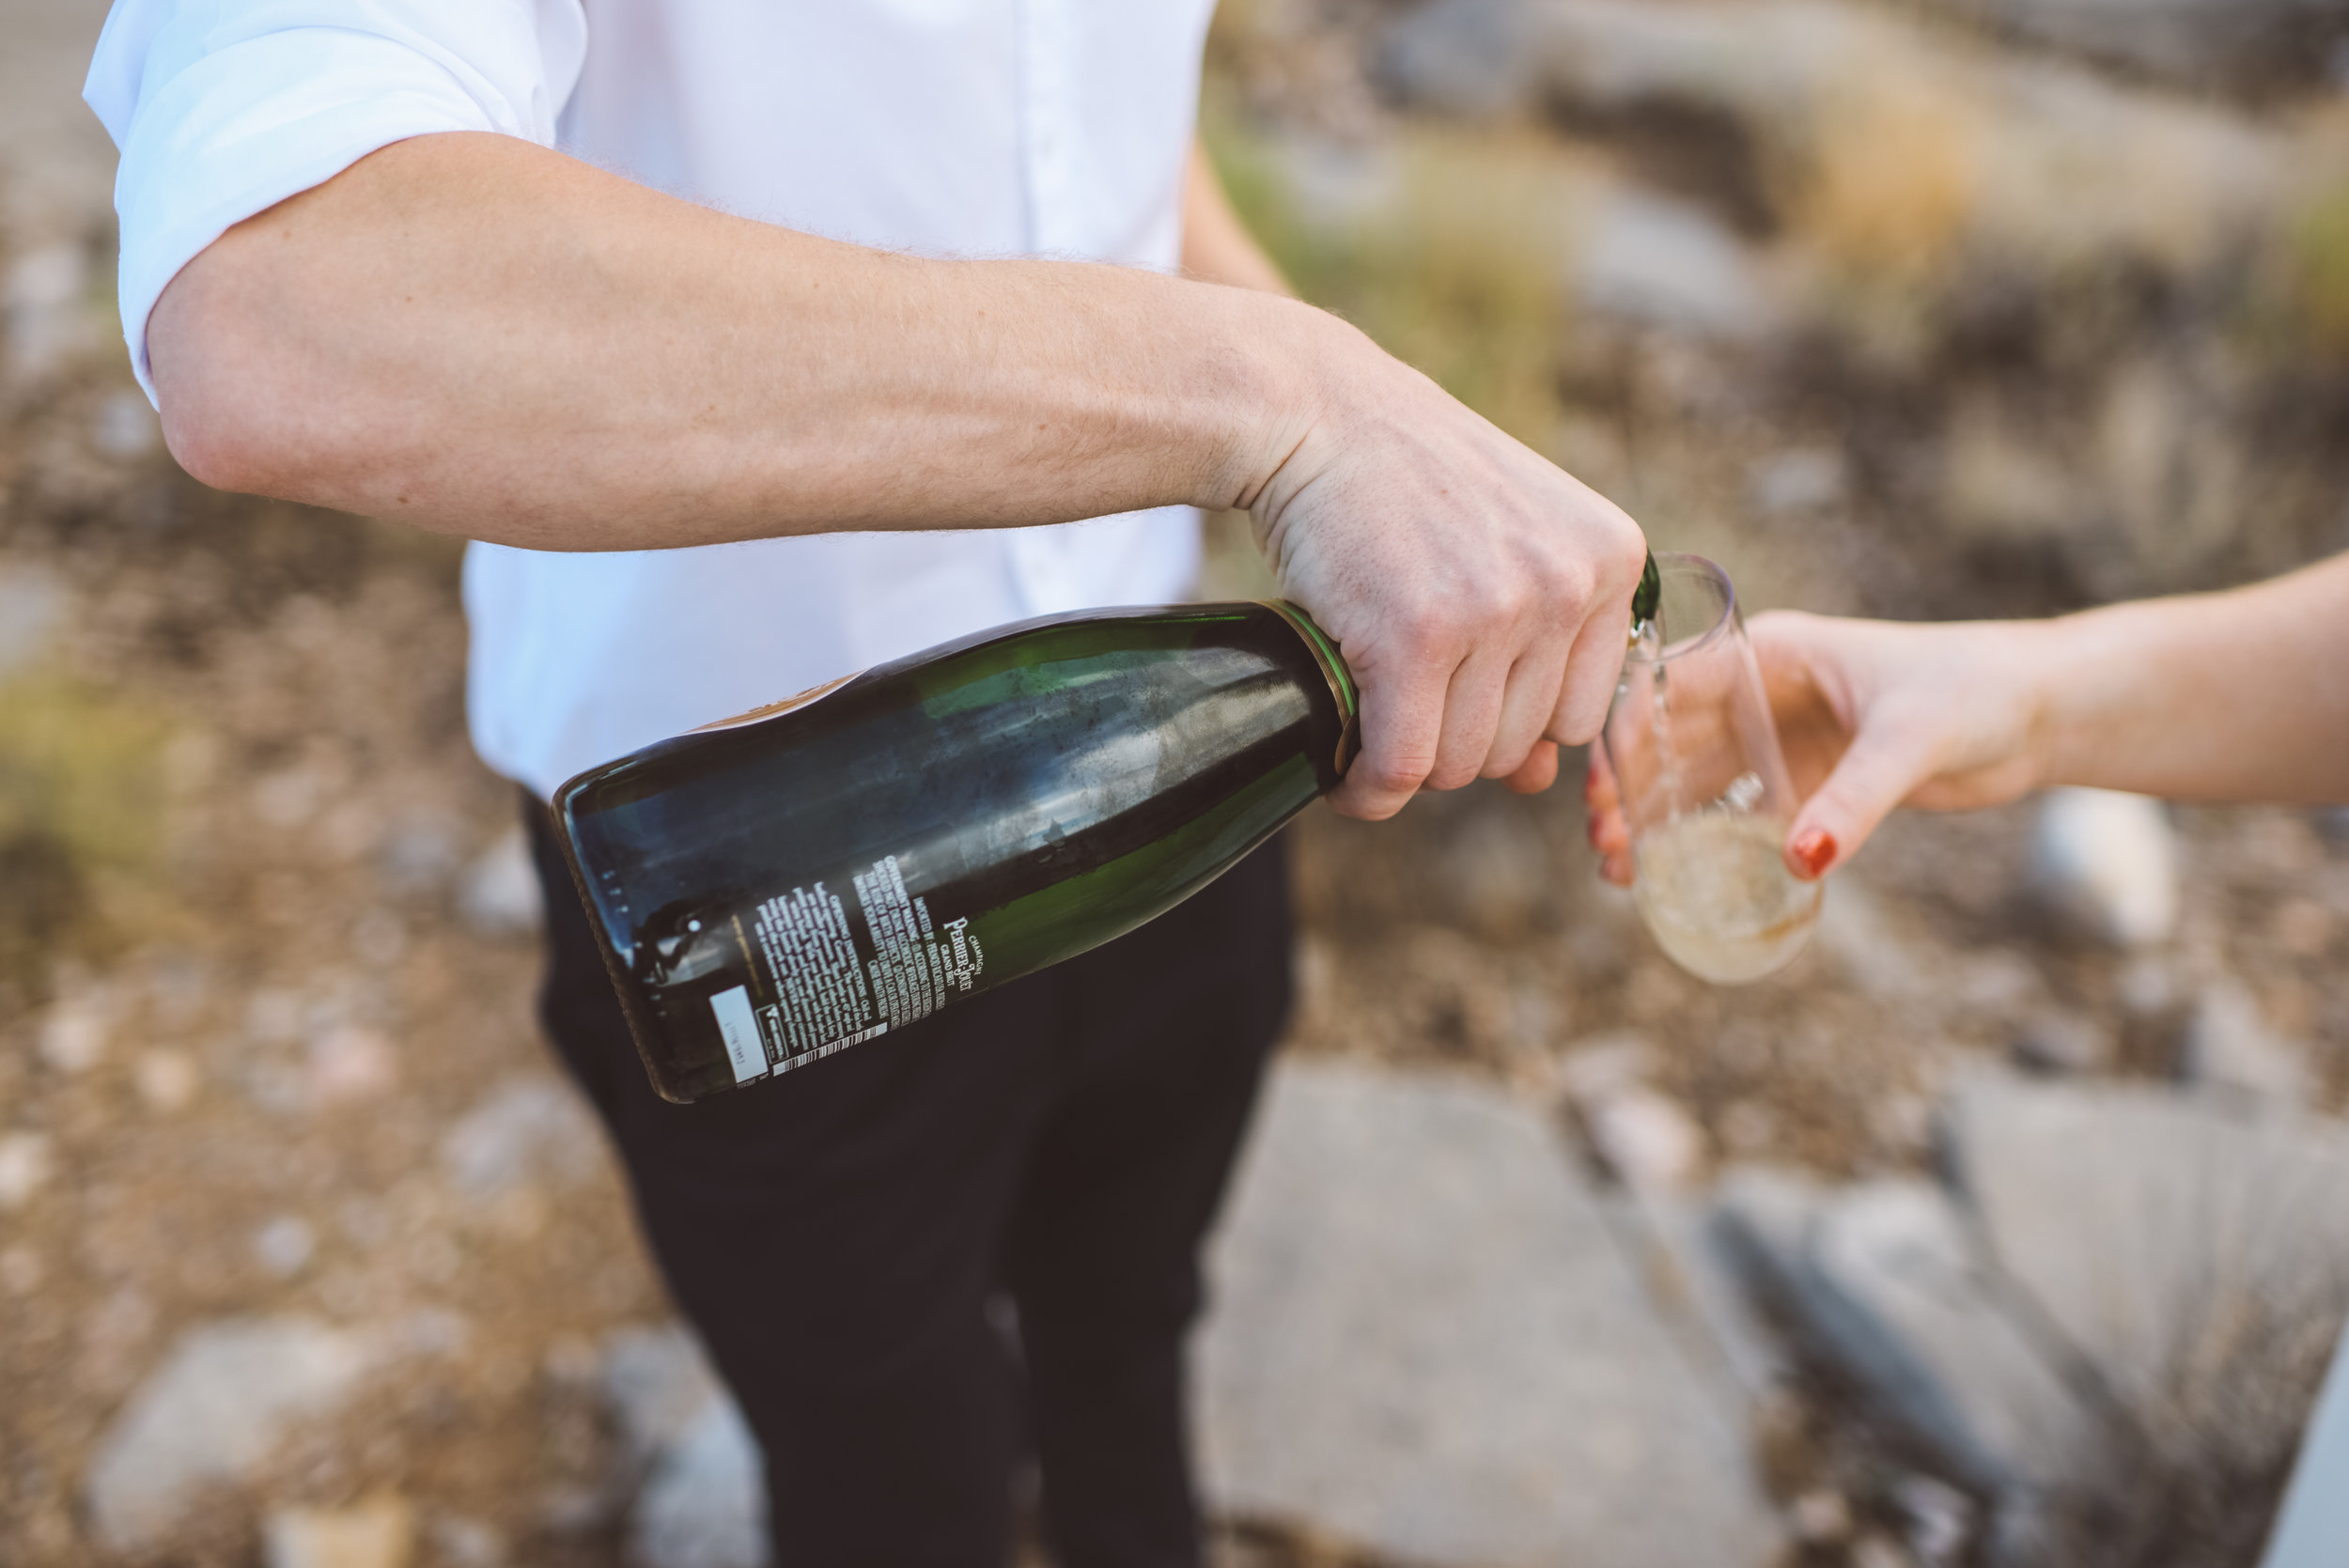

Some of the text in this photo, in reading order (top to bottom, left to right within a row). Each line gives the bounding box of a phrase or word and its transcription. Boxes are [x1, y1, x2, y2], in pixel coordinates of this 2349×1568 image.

[864, 871, 878, 888] THE
[873, 860, 893, 893] SHOULD
[807, 893, 817, 907] are
[852, 875, 870, 908] IMPAIRS
[869, 887, 883, 906] RISK
[884, 891, 897, 908] NOT
[863, 906, 877, 926] YOUR
[876, 904, 887, 916] OF
[890, 908, 904, 932] DRINK
[914, 896, 931, 934] IMPORTED
[815, 880, 830, 908] before
[832, 939, 848, 969] Caution
[843, 970, 853, 985] The
[879, 915, 894, 938] BIRTH
[886, 854, 909, 908] GOVERNMENT
[902, 907, 919, 941] WARNING
[914, 952, 929, 984] ACCORDING
[922, 983, 930, 991] TO
[829, 893, 851, 940] OPENING
[844, 939, 867, 998] INSTRUCTIONS
[869, 925, 885, 952] ABILITY
[924, 932, 934, 941] BY
[877, 951, 888, 961] TO
[896, 931, 913, 968] ALCOHOLIC
[926, 942, 941, 967] PERNOD
[968, 935, 983, 975] CHAMPAGNE
[868, 959, 880, 980] CAUSE
[880, 960, 893, 980] DRIVE
[932, 966, 943, 986] RICARD
[941, 943, 955, 986] GRAND BRUT
[785, 977, 799, 1005] NEVER
[873, 978, 885, 1001] HEALTH
[886, 982, 895, 995] CAR
[895, 971, 910, 1006] CONSUMPTION
[906, 966, 919, 994] BEVERAGES
